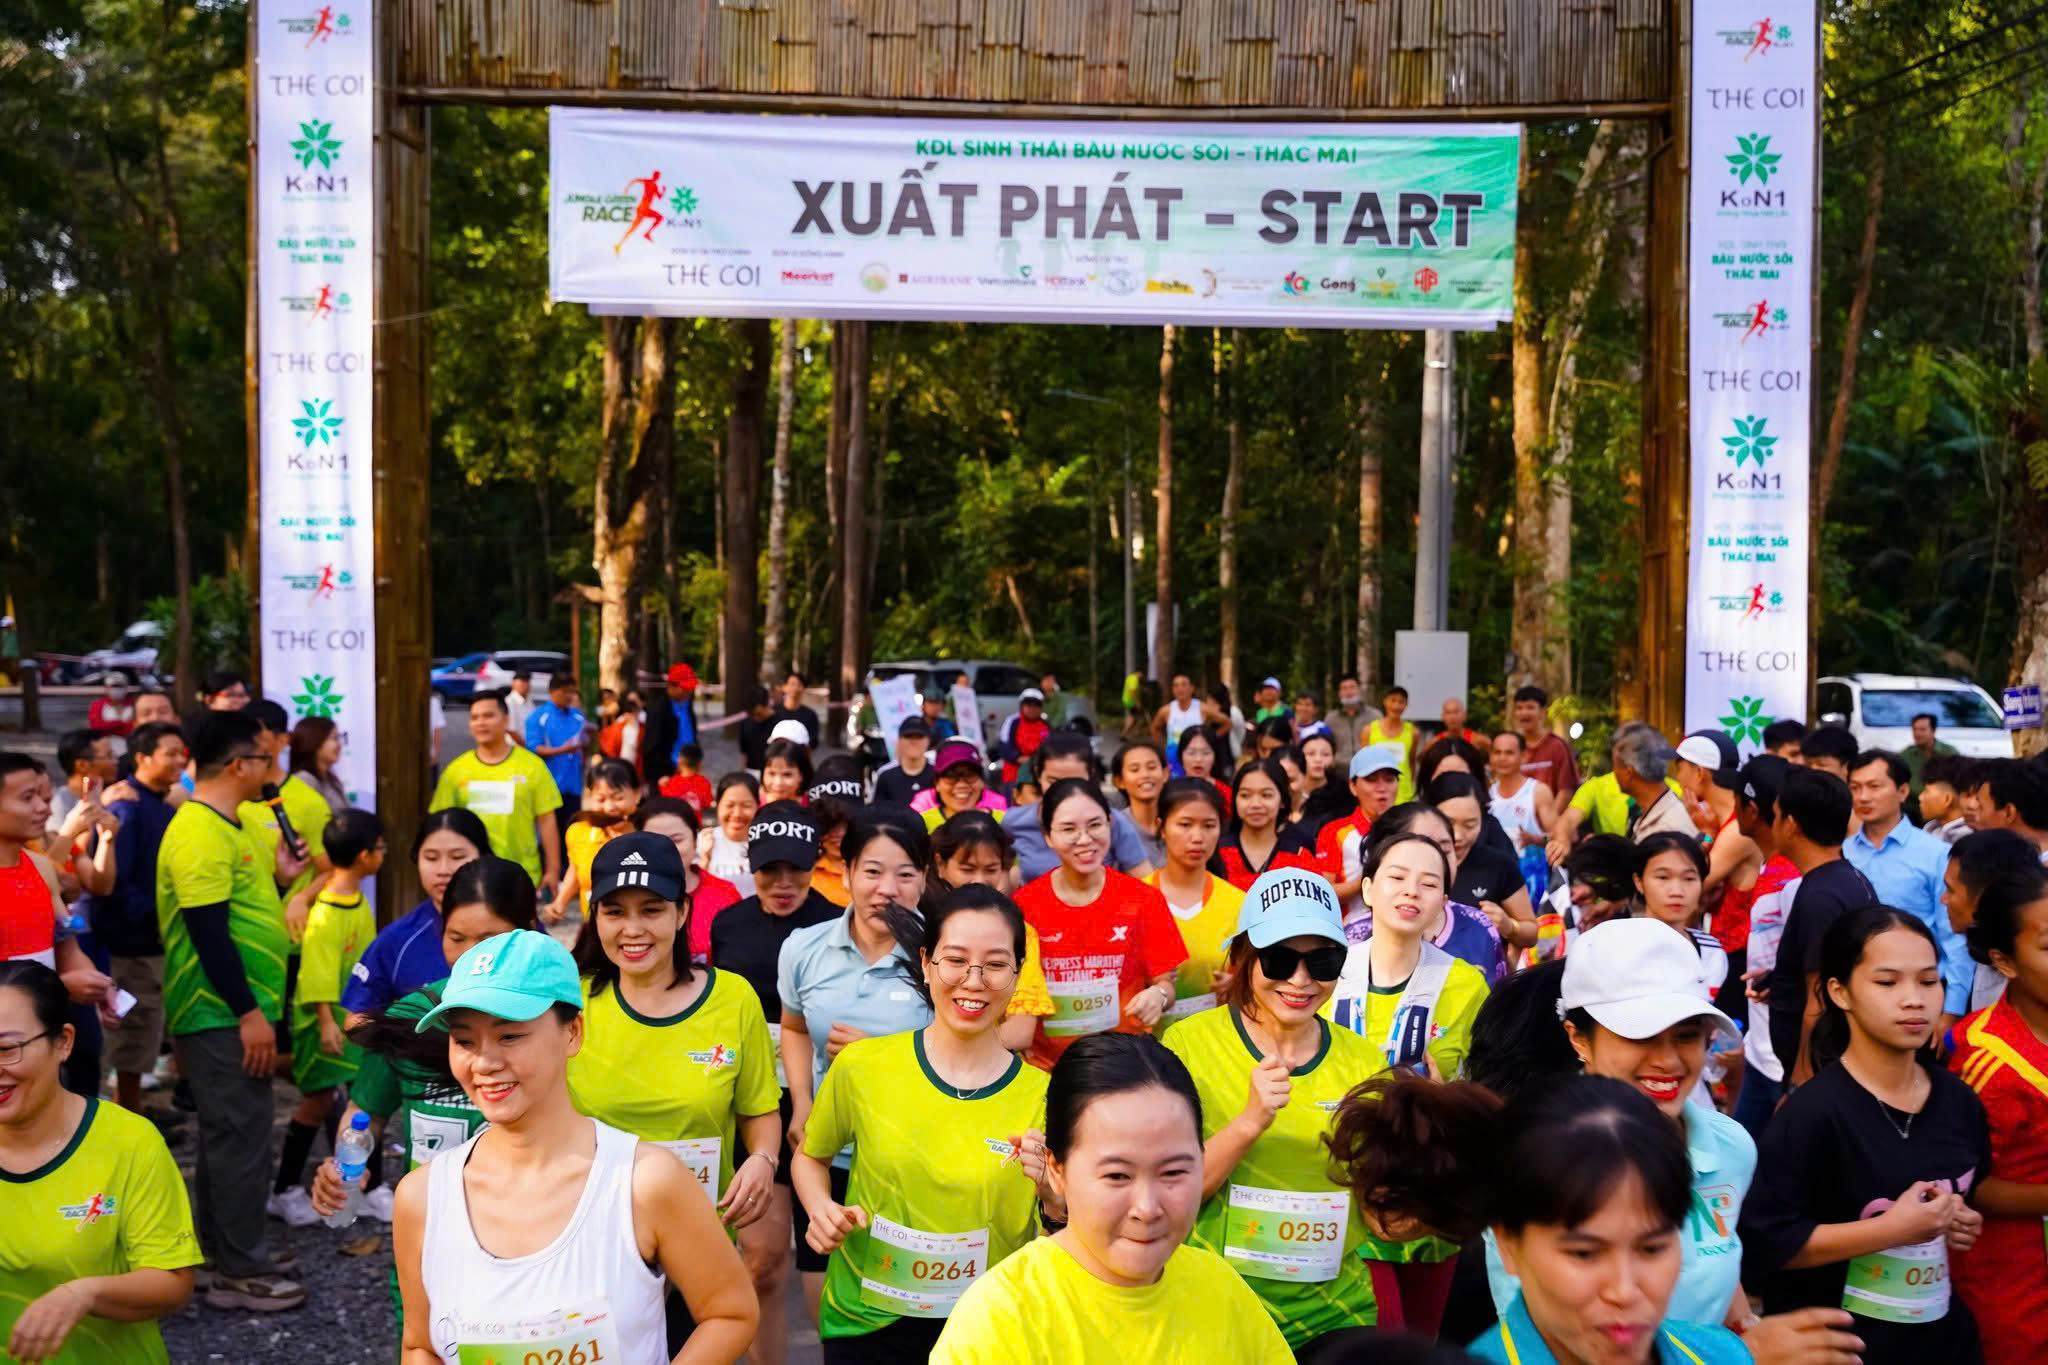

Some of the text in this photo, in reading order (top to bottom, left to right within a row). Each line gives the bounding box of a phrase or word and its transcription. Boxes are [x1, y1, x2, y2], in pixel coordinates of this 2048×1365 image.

[270, 74, 364, 96] THE COI
[1706, 87, 1804, 109] THE COI
[916, 138, 956, 156] KDL
[963, 140, 1012, 156] SINH
[1192, 142, 1230, 161] SÔI
[1317, 147, 1357, 163] MAI
[583, 206, 632, 222] RACE
[791, 161, 977, 237] XUẤT
[1001, 171, 1183, 241] PHÁT
[1258, 187, 1484, 249] START
[662, 264, 760, 286] THE COI
[1703, 370, 1800, 392] THE COI
[271, 630, 365, 650] THE COI
[1699, 651, 1796, 673] THE COI
[808, 780, 863, 801] SPORT
[748, 820, 816, 843] SPORT
[1260, 878, 1332, 913] HOPKINS
[1073, 994, 1112, 1012] 0259
[1234, 1191, 1253, 1200] THE
[875, 1220, 908, 1240] THE COI
[1279, 1221, 1338, 1241] 0253
[912, 1259, 976, 1280] 0264
[523, 1338, 604, 1365] 0261
